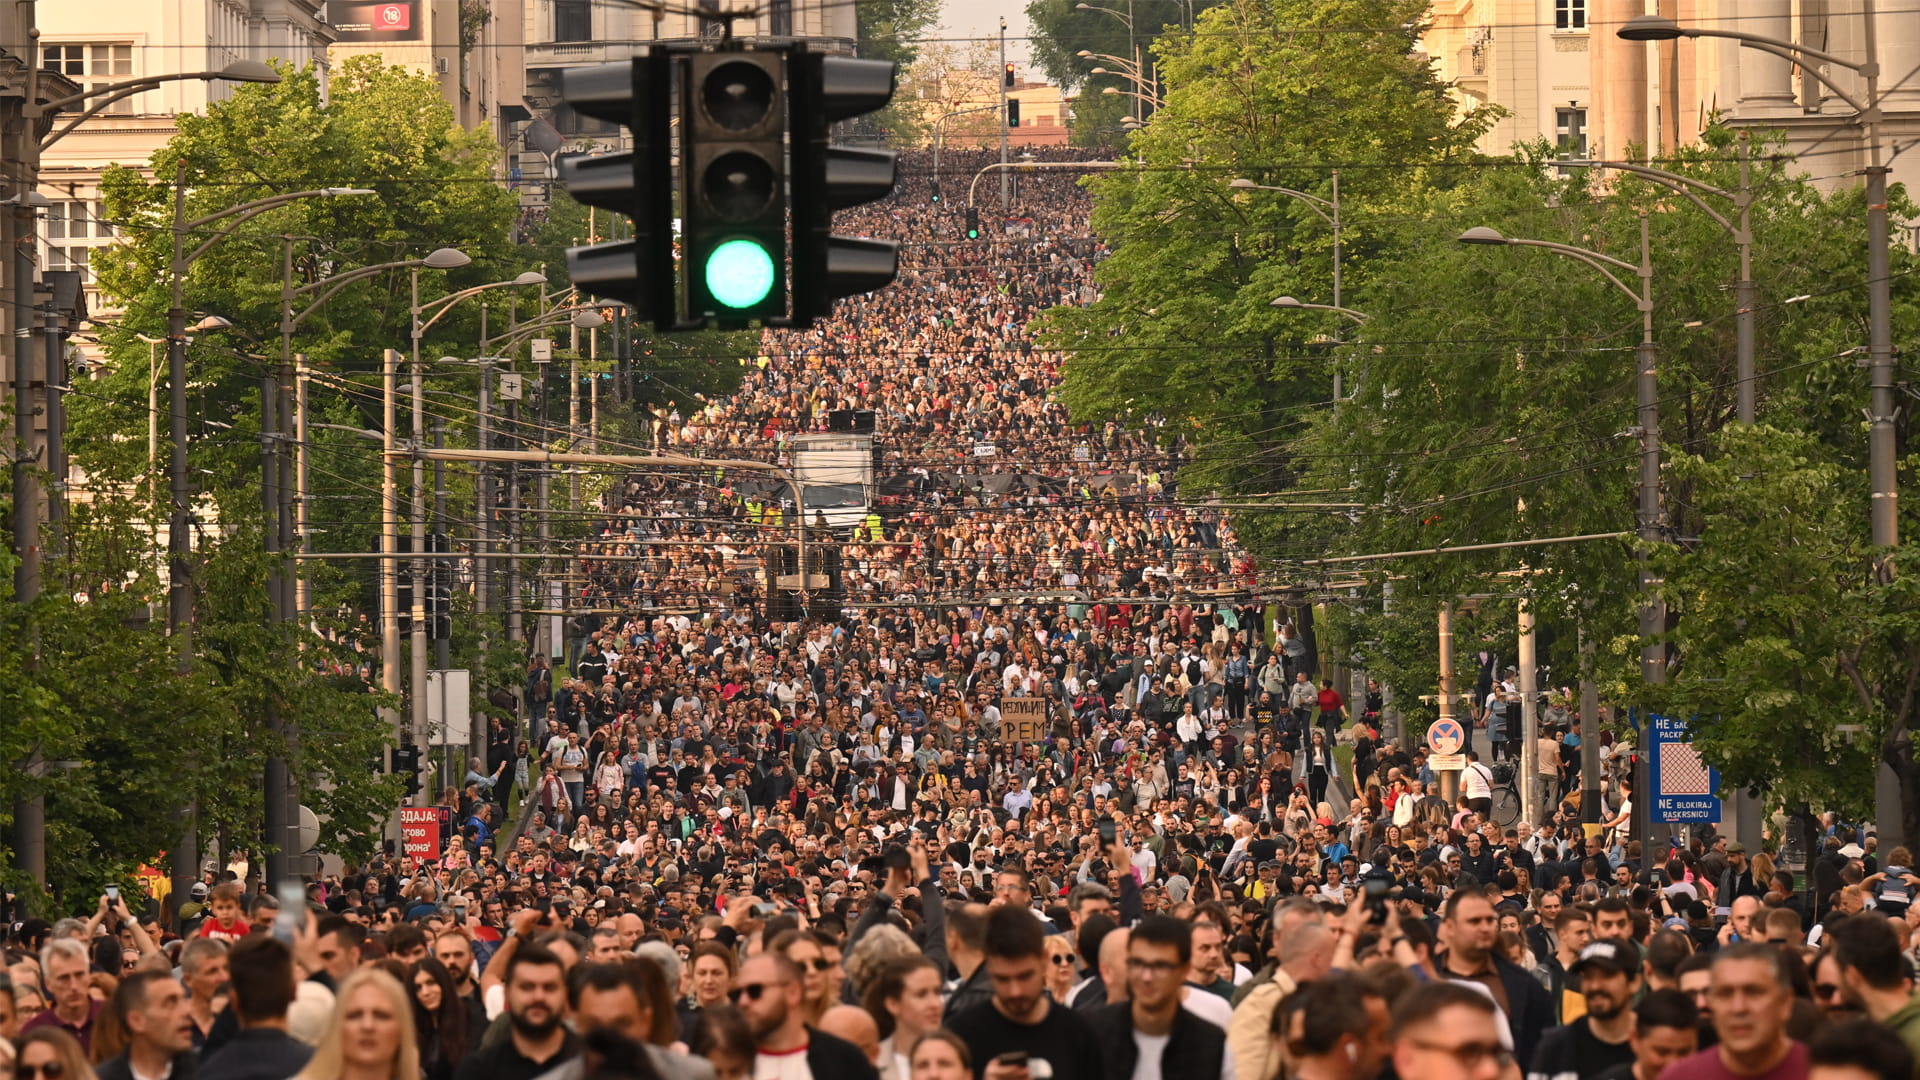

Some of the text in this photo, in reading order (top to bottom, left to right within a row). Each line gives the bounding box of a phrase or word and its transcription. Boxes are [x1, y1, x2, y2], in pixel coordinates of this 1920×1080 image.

[386, 10, 398, 21] 18
[1655, 719, 1670, 730] НЕ
[1004, 721, 1045, 740] РЕМ
[1658, 799, 1712, 809] NE BLOKIRAJ
[400, 810, 437, 824] ЗДАЈА:
[1662, 810, 1709, 818] RASKRSNICU
